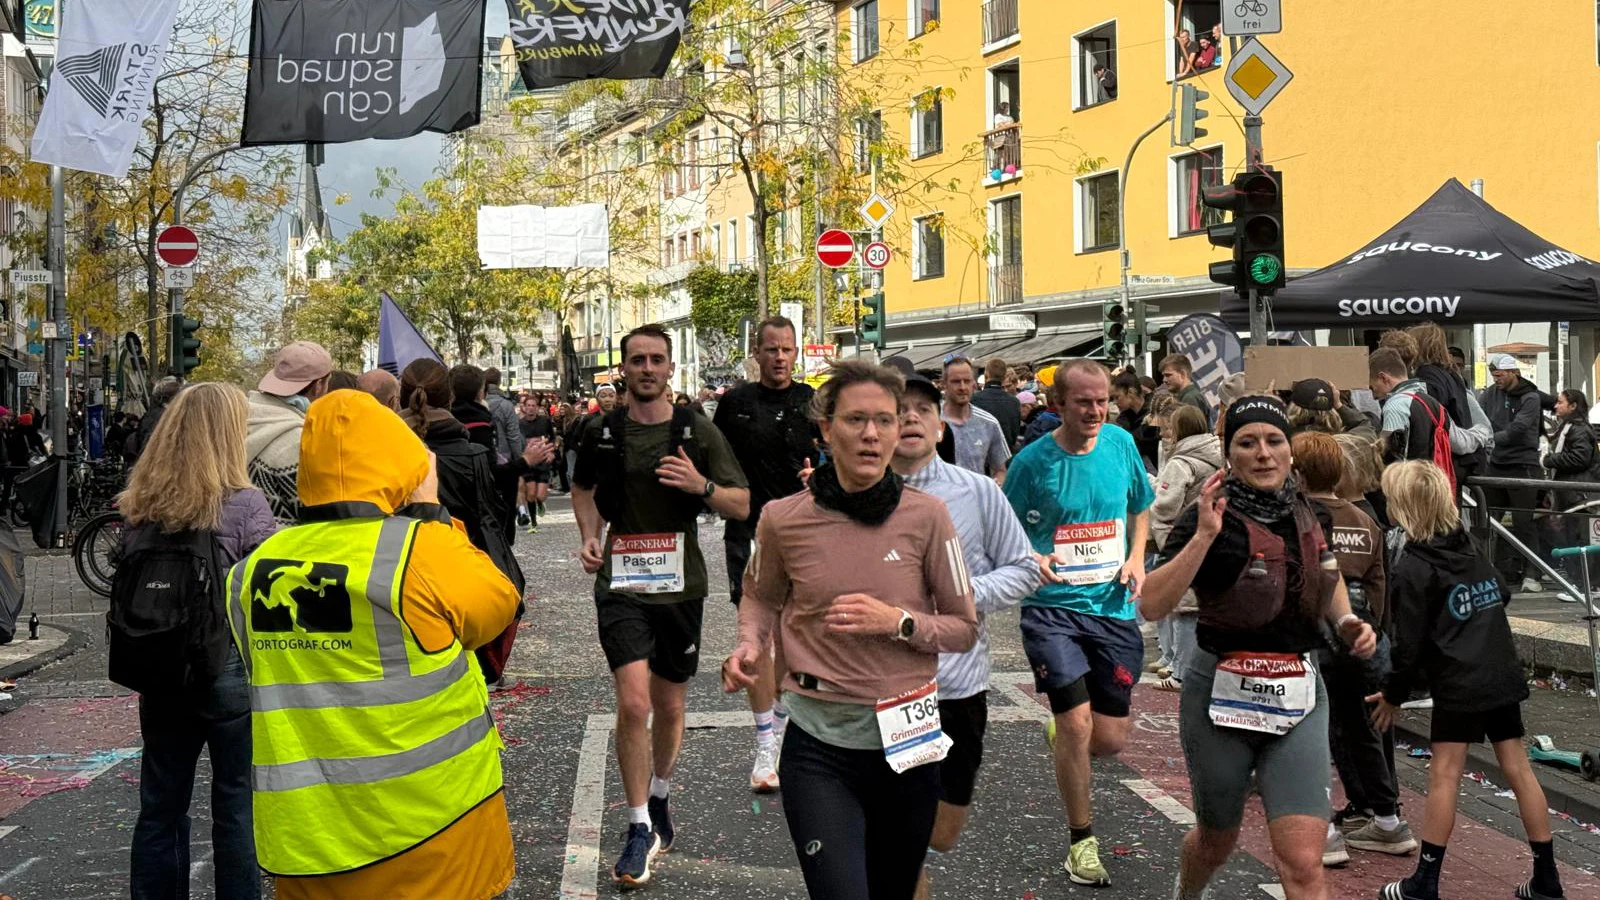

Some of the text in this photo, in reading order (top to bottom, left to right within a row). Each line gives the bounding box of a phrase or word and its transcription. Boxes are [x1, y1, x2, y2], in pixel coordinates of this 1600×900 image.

[1243, 19, 1261, 29] frei
[870, 249, 885, 261] 30
[1347, 241, 1502, 264] saucony
[14, 272, 48, 283] Piusstr.
[1339, 296, 1461, 318] saucony
[1236, 401, 1290, 424] GARMIN
[1070, 525, 1115, 540] GENERALI
[626, 538, 676, 550] GENERALI
[1074, 543, 1104, 557] Nick
[623, 554, 666, 567] Pascal
[1243, 659, 1304, 673] GENERALI
[1240, 677, 1286, 696] Lana
